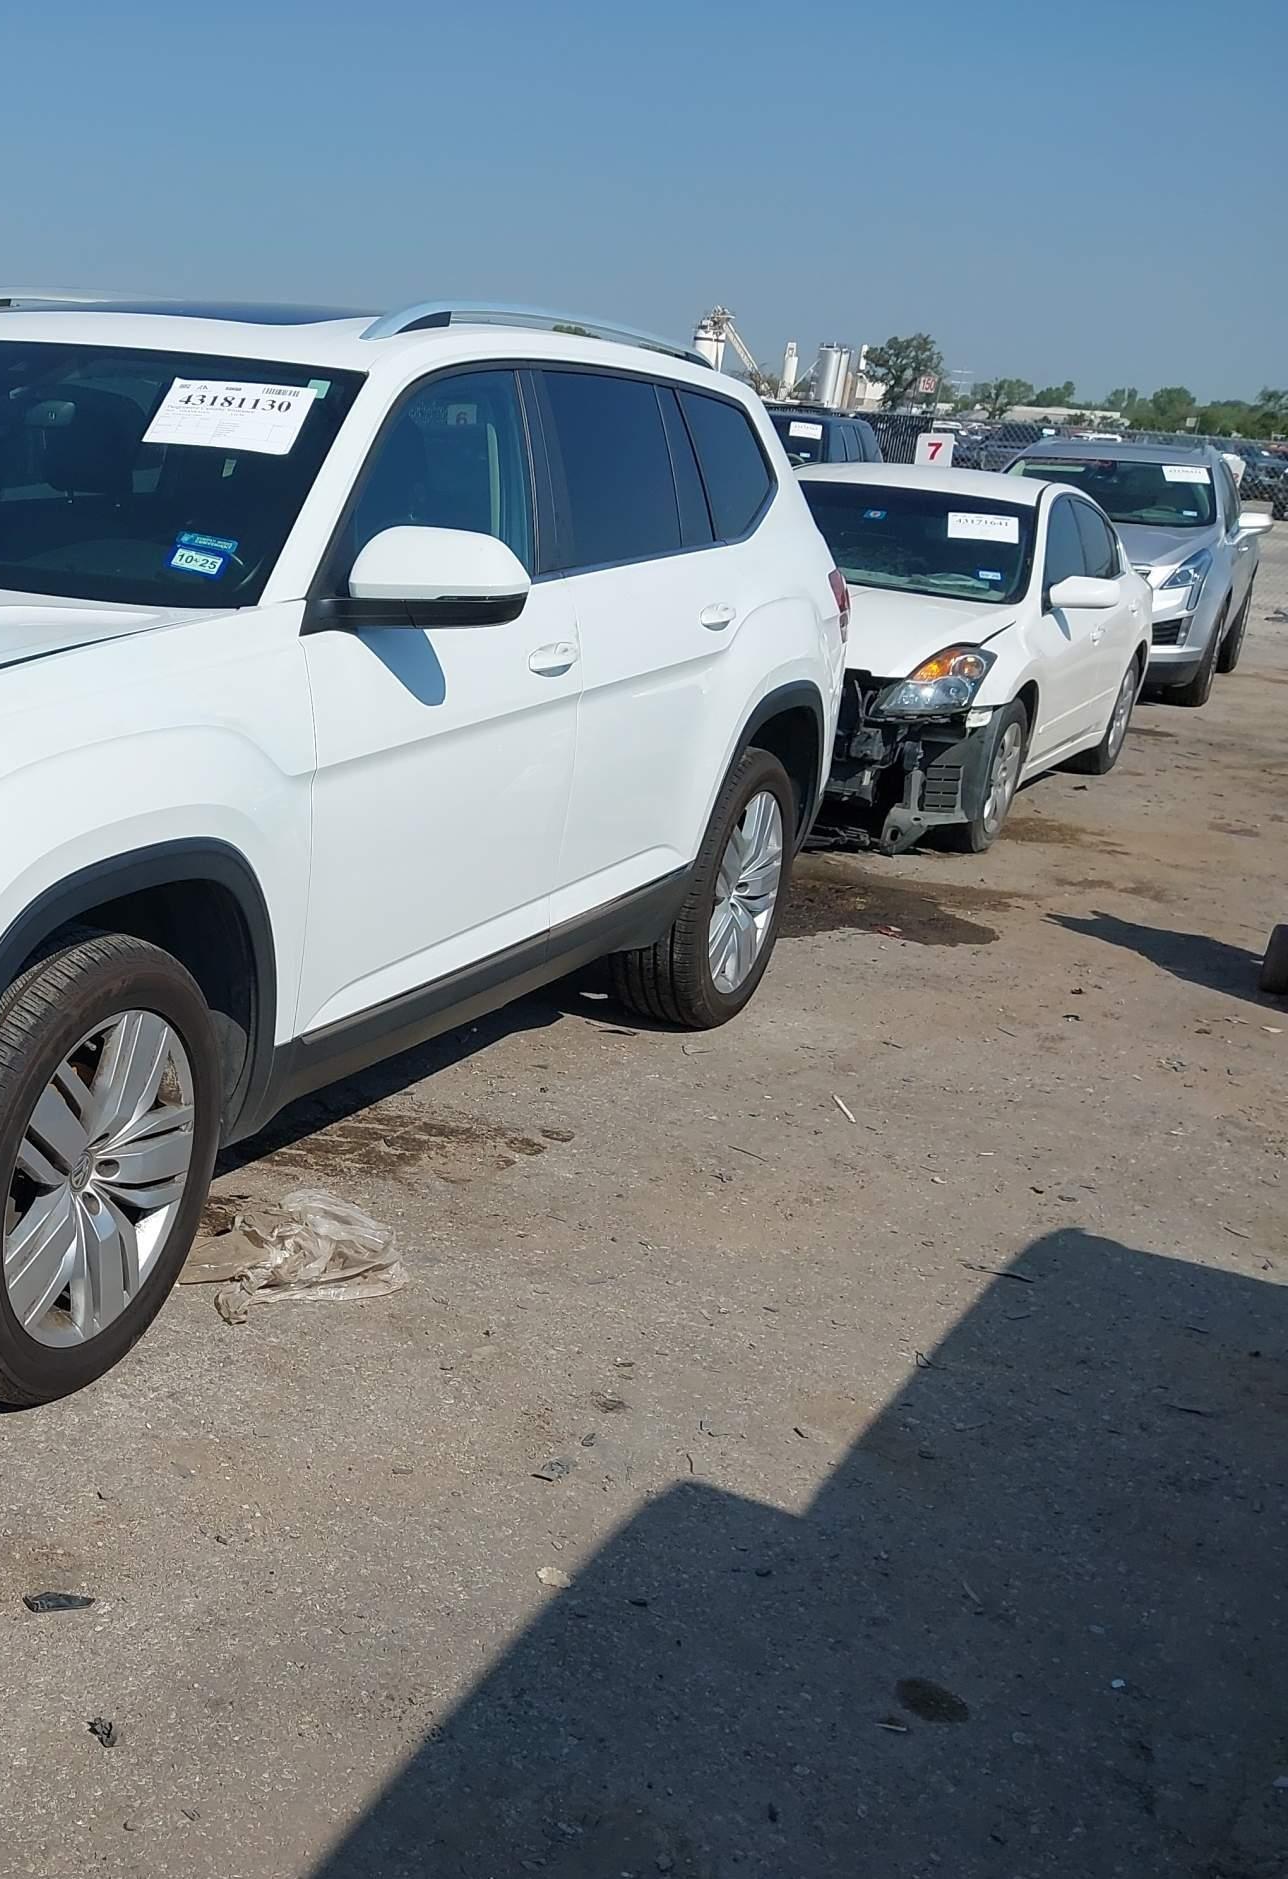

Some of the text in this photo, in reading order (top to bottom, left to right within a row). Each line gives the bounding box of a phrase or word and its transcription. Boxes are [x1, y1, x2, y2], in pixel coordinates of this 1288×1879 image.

[921, 378, 936, 391] 150
[179, 393, 292, 413] 43181130
[927, 442, 943, 460] 7
